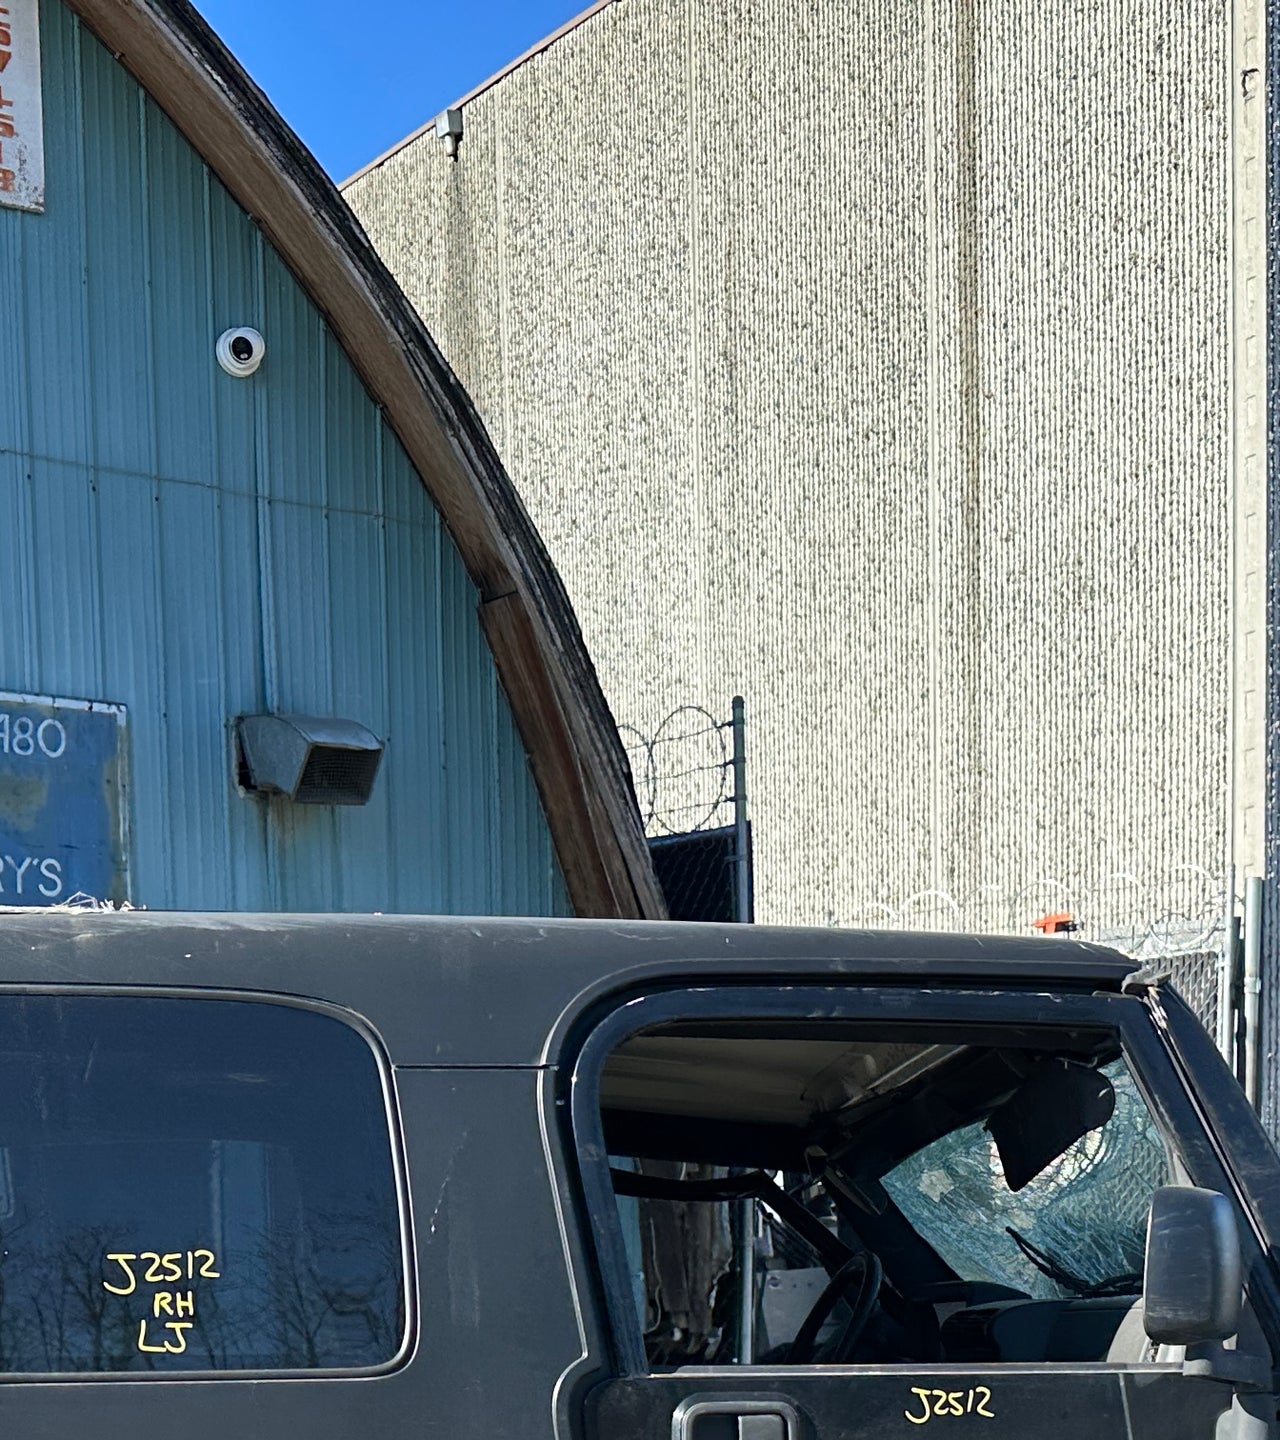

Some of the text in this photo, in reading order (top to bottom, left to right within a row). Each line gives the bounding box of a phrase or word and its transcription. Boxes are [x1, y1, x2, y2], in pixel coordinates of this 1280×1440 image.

[103, 1249, 220, 1295] J2512
[153, 1291, 194, 1318] RH
[138, 1319, 193, 1354] LJ
[904, 1386, 995, 1424] J2512
